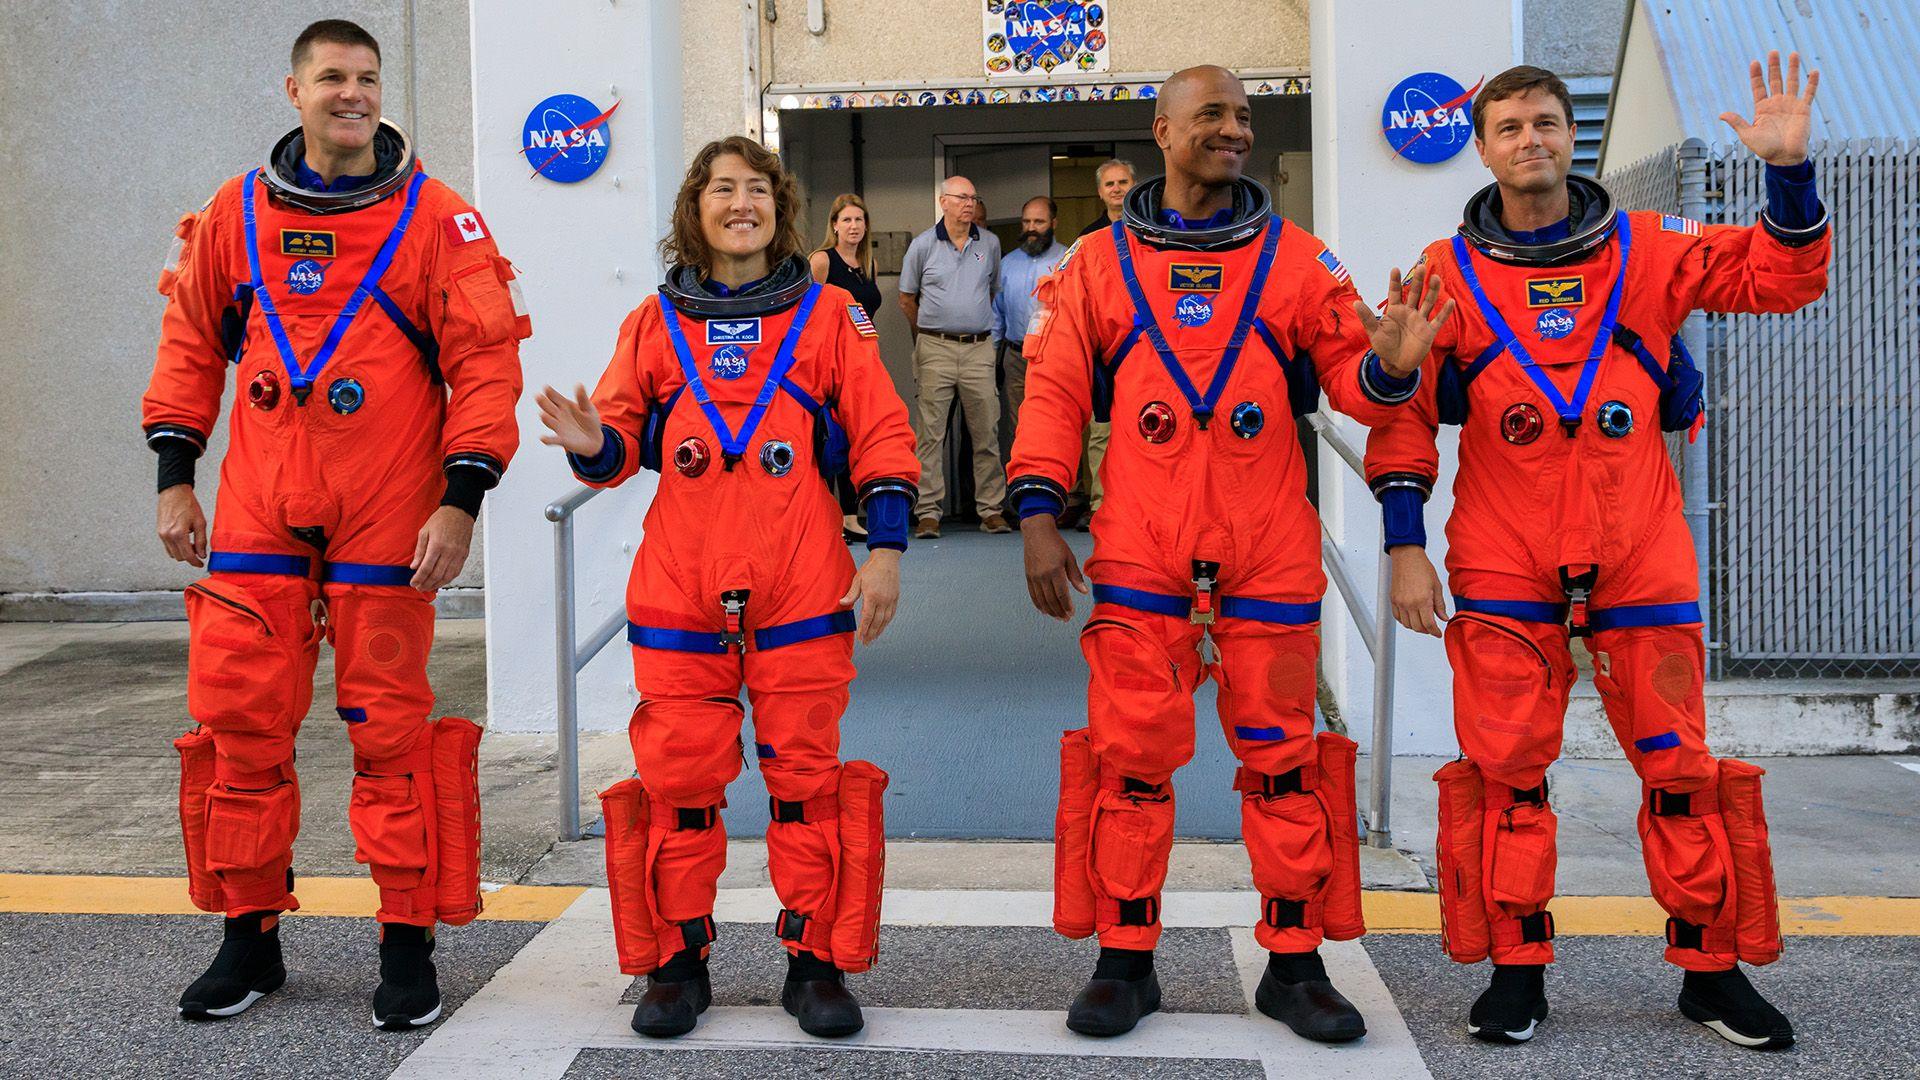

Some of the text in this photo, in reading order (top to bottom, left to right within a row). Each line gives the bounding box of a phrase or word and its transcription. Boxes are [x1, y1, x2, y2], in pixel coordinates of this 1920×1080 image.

[1012, 19, 1082, 37] NASA
[1389, 107, 1470, 129] NASA
[529, 128, 606, 148] NASA
[290, 272, 322, 282] NASA
[1178, 304, 1211, 315] NASA
[1539, 317, 1574, 328] NASA
[714, 357, 747, 367] NASA
